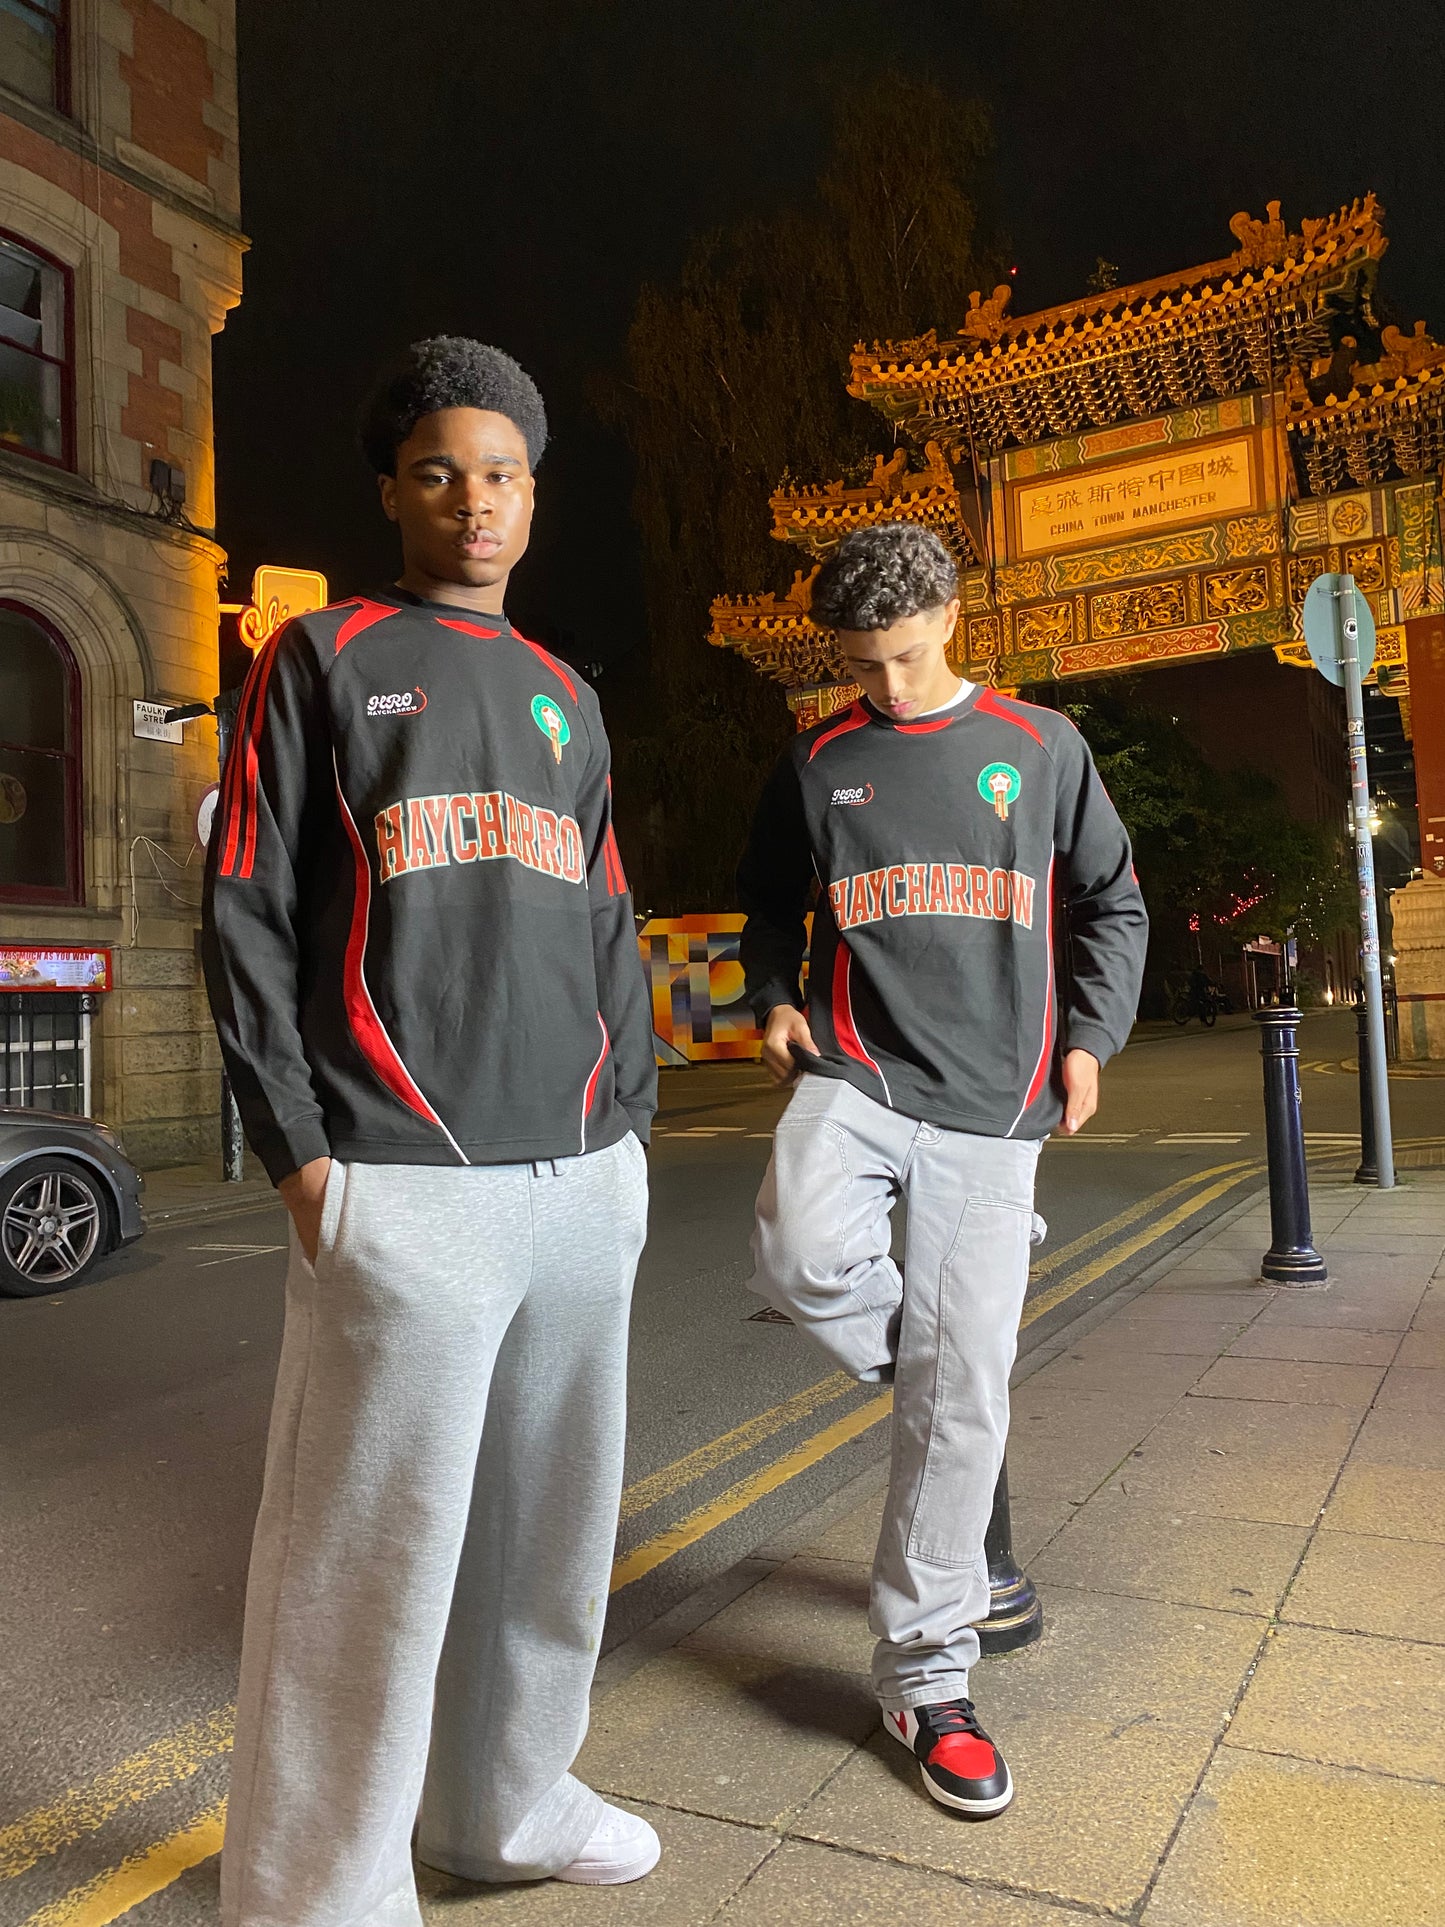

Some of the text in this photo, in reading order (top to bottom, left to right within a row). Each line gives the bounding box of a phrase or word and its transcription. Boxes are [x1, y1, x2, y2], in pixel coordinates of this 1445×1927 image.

[1050, 492, 1217, 536] CHINA TOWN MANCHESTER
[143, 713, 173, 726] STRE
[374, 791, 588, 889] HAYCHARRO
[828, 863, 1036, 931] HAYCHARROW
[19, 952, 42, 961] MUCH
[44, 952, 54, 961] AS
[56, 953, 71, 961] YOU
[73, 953, 93, 961] WANT
